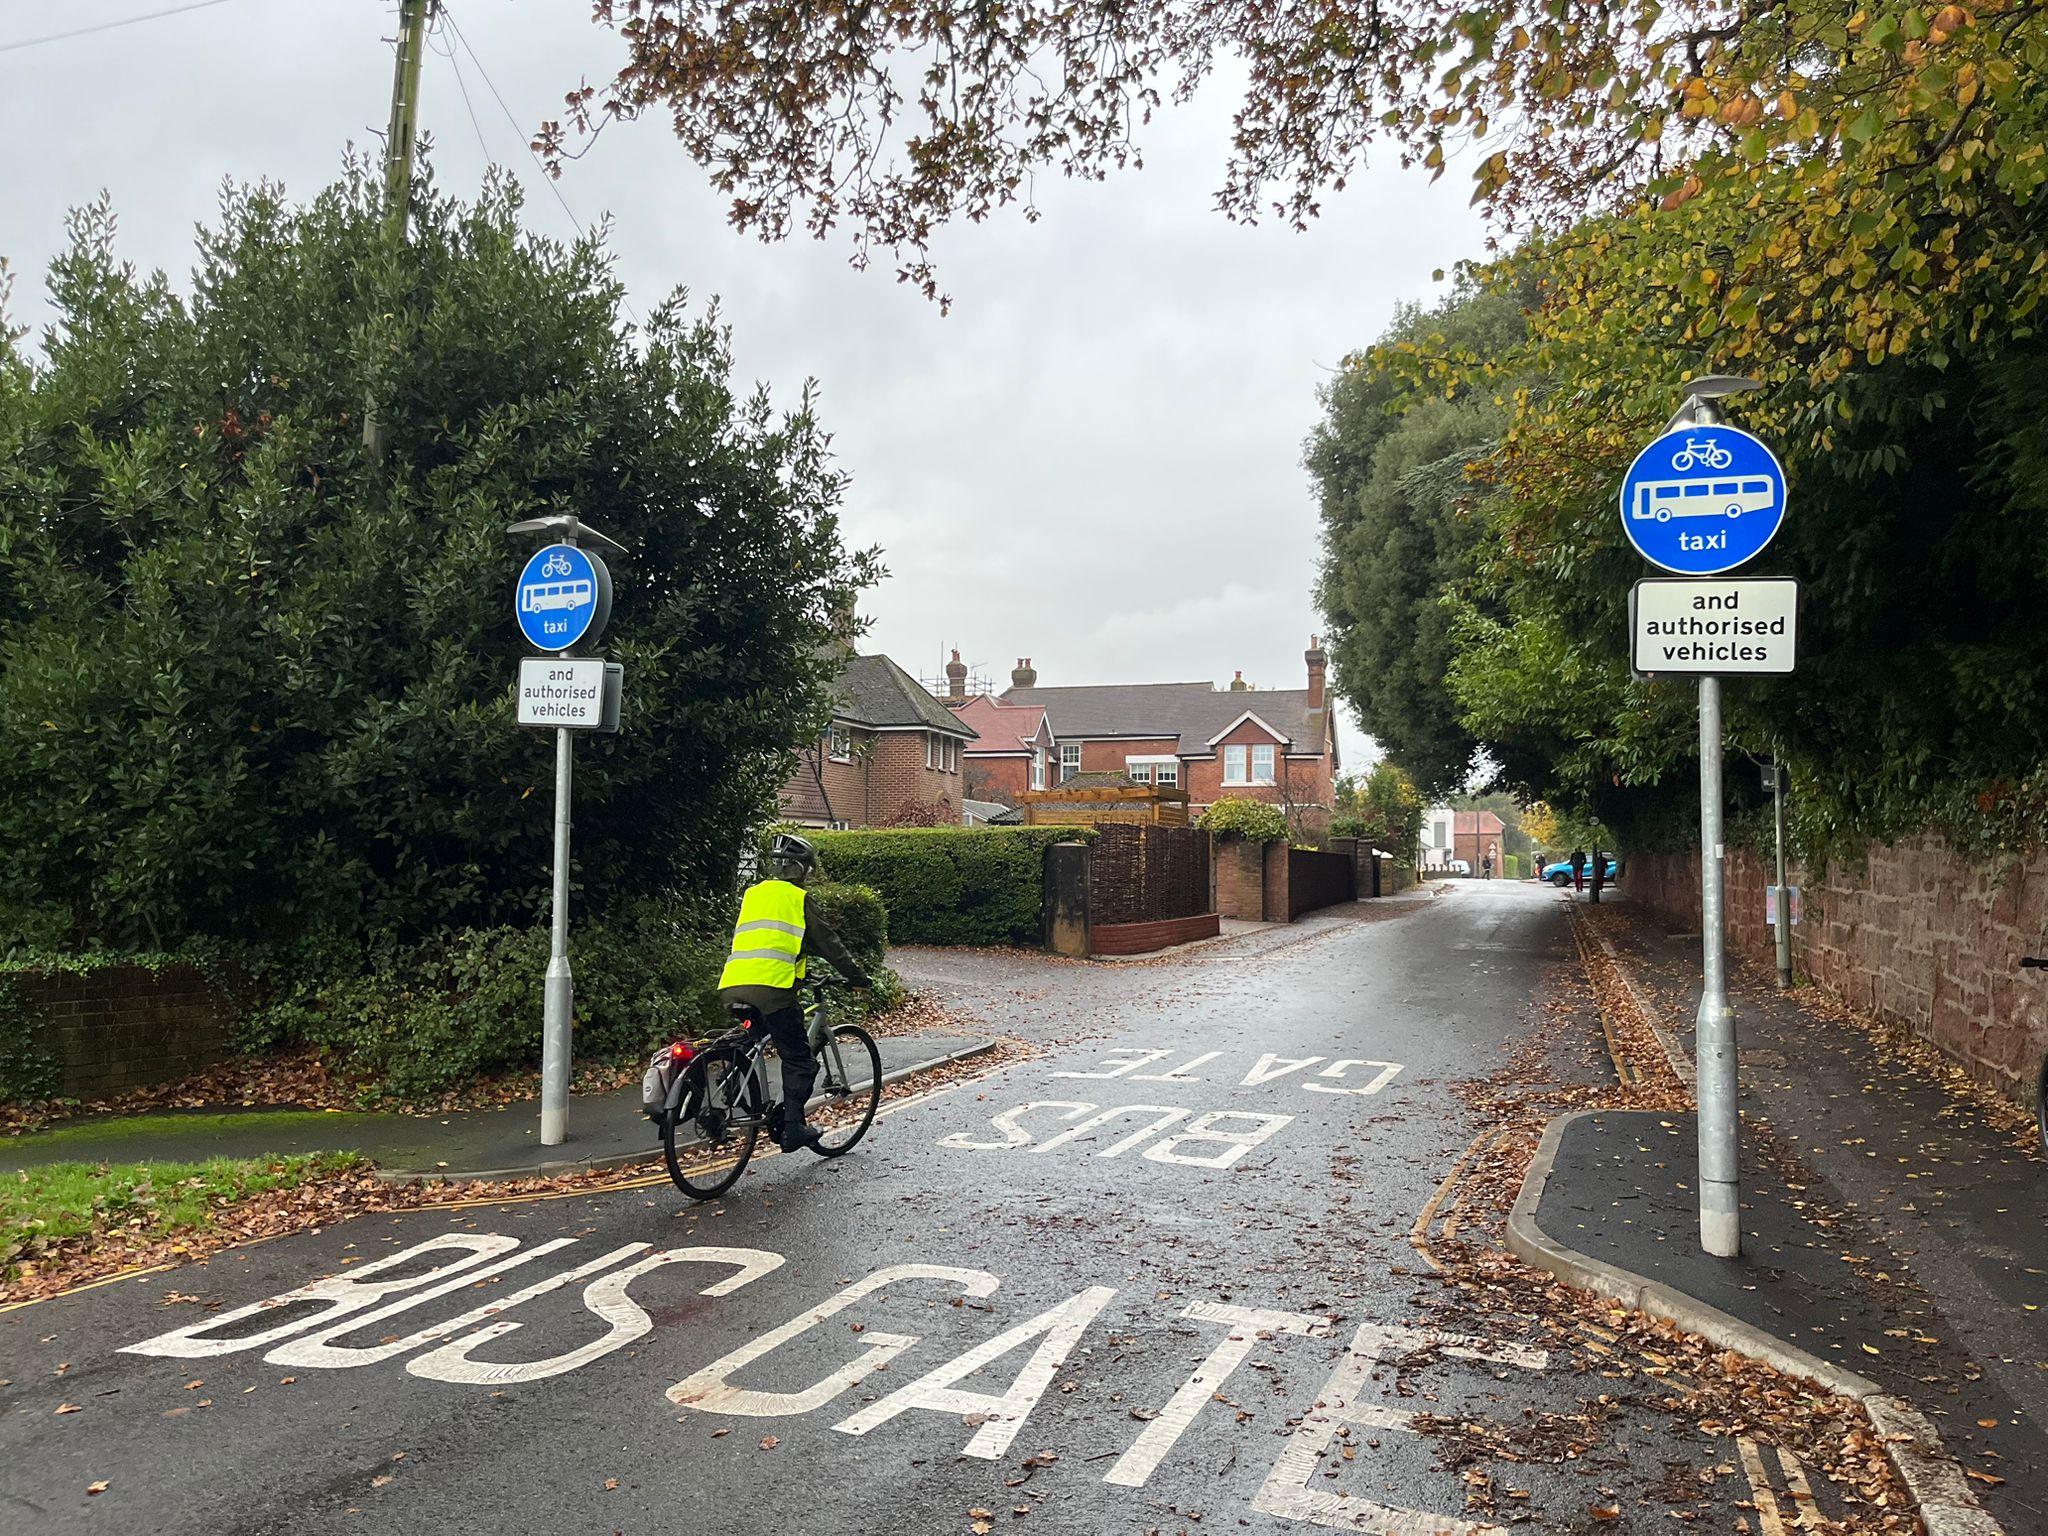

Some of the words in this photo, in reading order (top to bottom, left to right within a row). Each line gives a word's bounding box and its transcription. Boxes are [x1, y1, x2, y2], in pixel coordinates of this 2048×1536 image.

[1678, 529, 1727, 551] taxi
[1692, 590, 1739, 610] and
[543, 618, 567, 634] taxi
[1646, 616, 1785, 635] authorised
[1662, 642, 1767, 661] vehicles
[548, 667, 574, 681] and
[524, 684, 596, 700] authorised
[532, 703, 586, 717] vehicles
[1047, 1048, 1404, 1095] GATE
[935, 1101, 1296, 1168] BUS
[115, 1233, 786, 1385] BUS
[665, 1264, 1549, 1536] GATE
